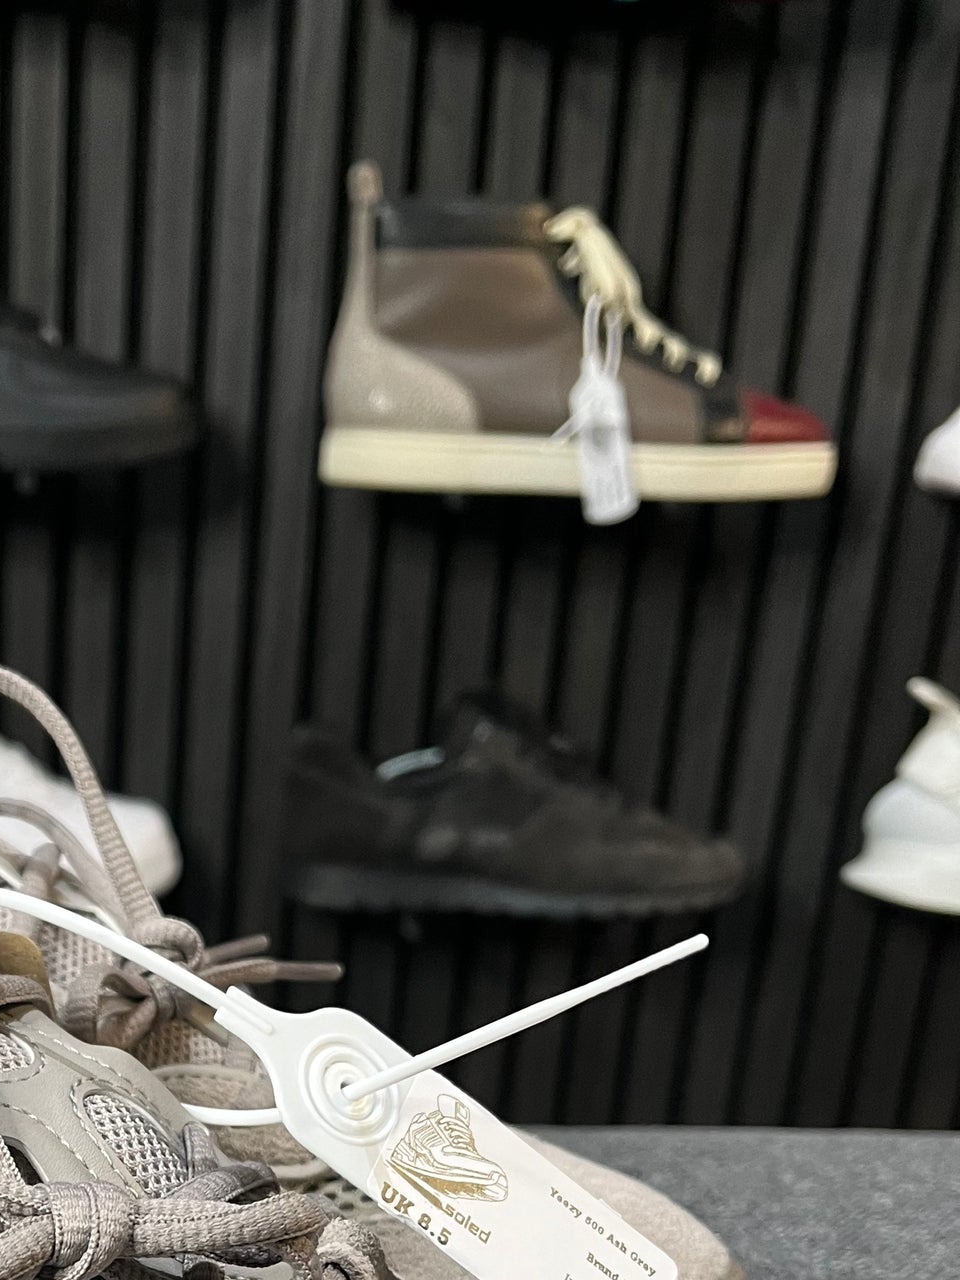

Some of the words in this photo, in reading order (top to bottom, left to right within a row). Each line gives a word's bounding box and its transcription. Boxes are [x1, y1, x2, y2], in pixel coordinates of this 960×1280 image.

[380, 1181, 415, 1217] UK
[417, 1213, 452, 1246] 8.5
[550, 1186, 583, 1218] Yeezy
[584, 1216, 605, 1235] 500
[606, 1234, 628, 1254] Ash
[630, 1251, 657, 1278] Grey
